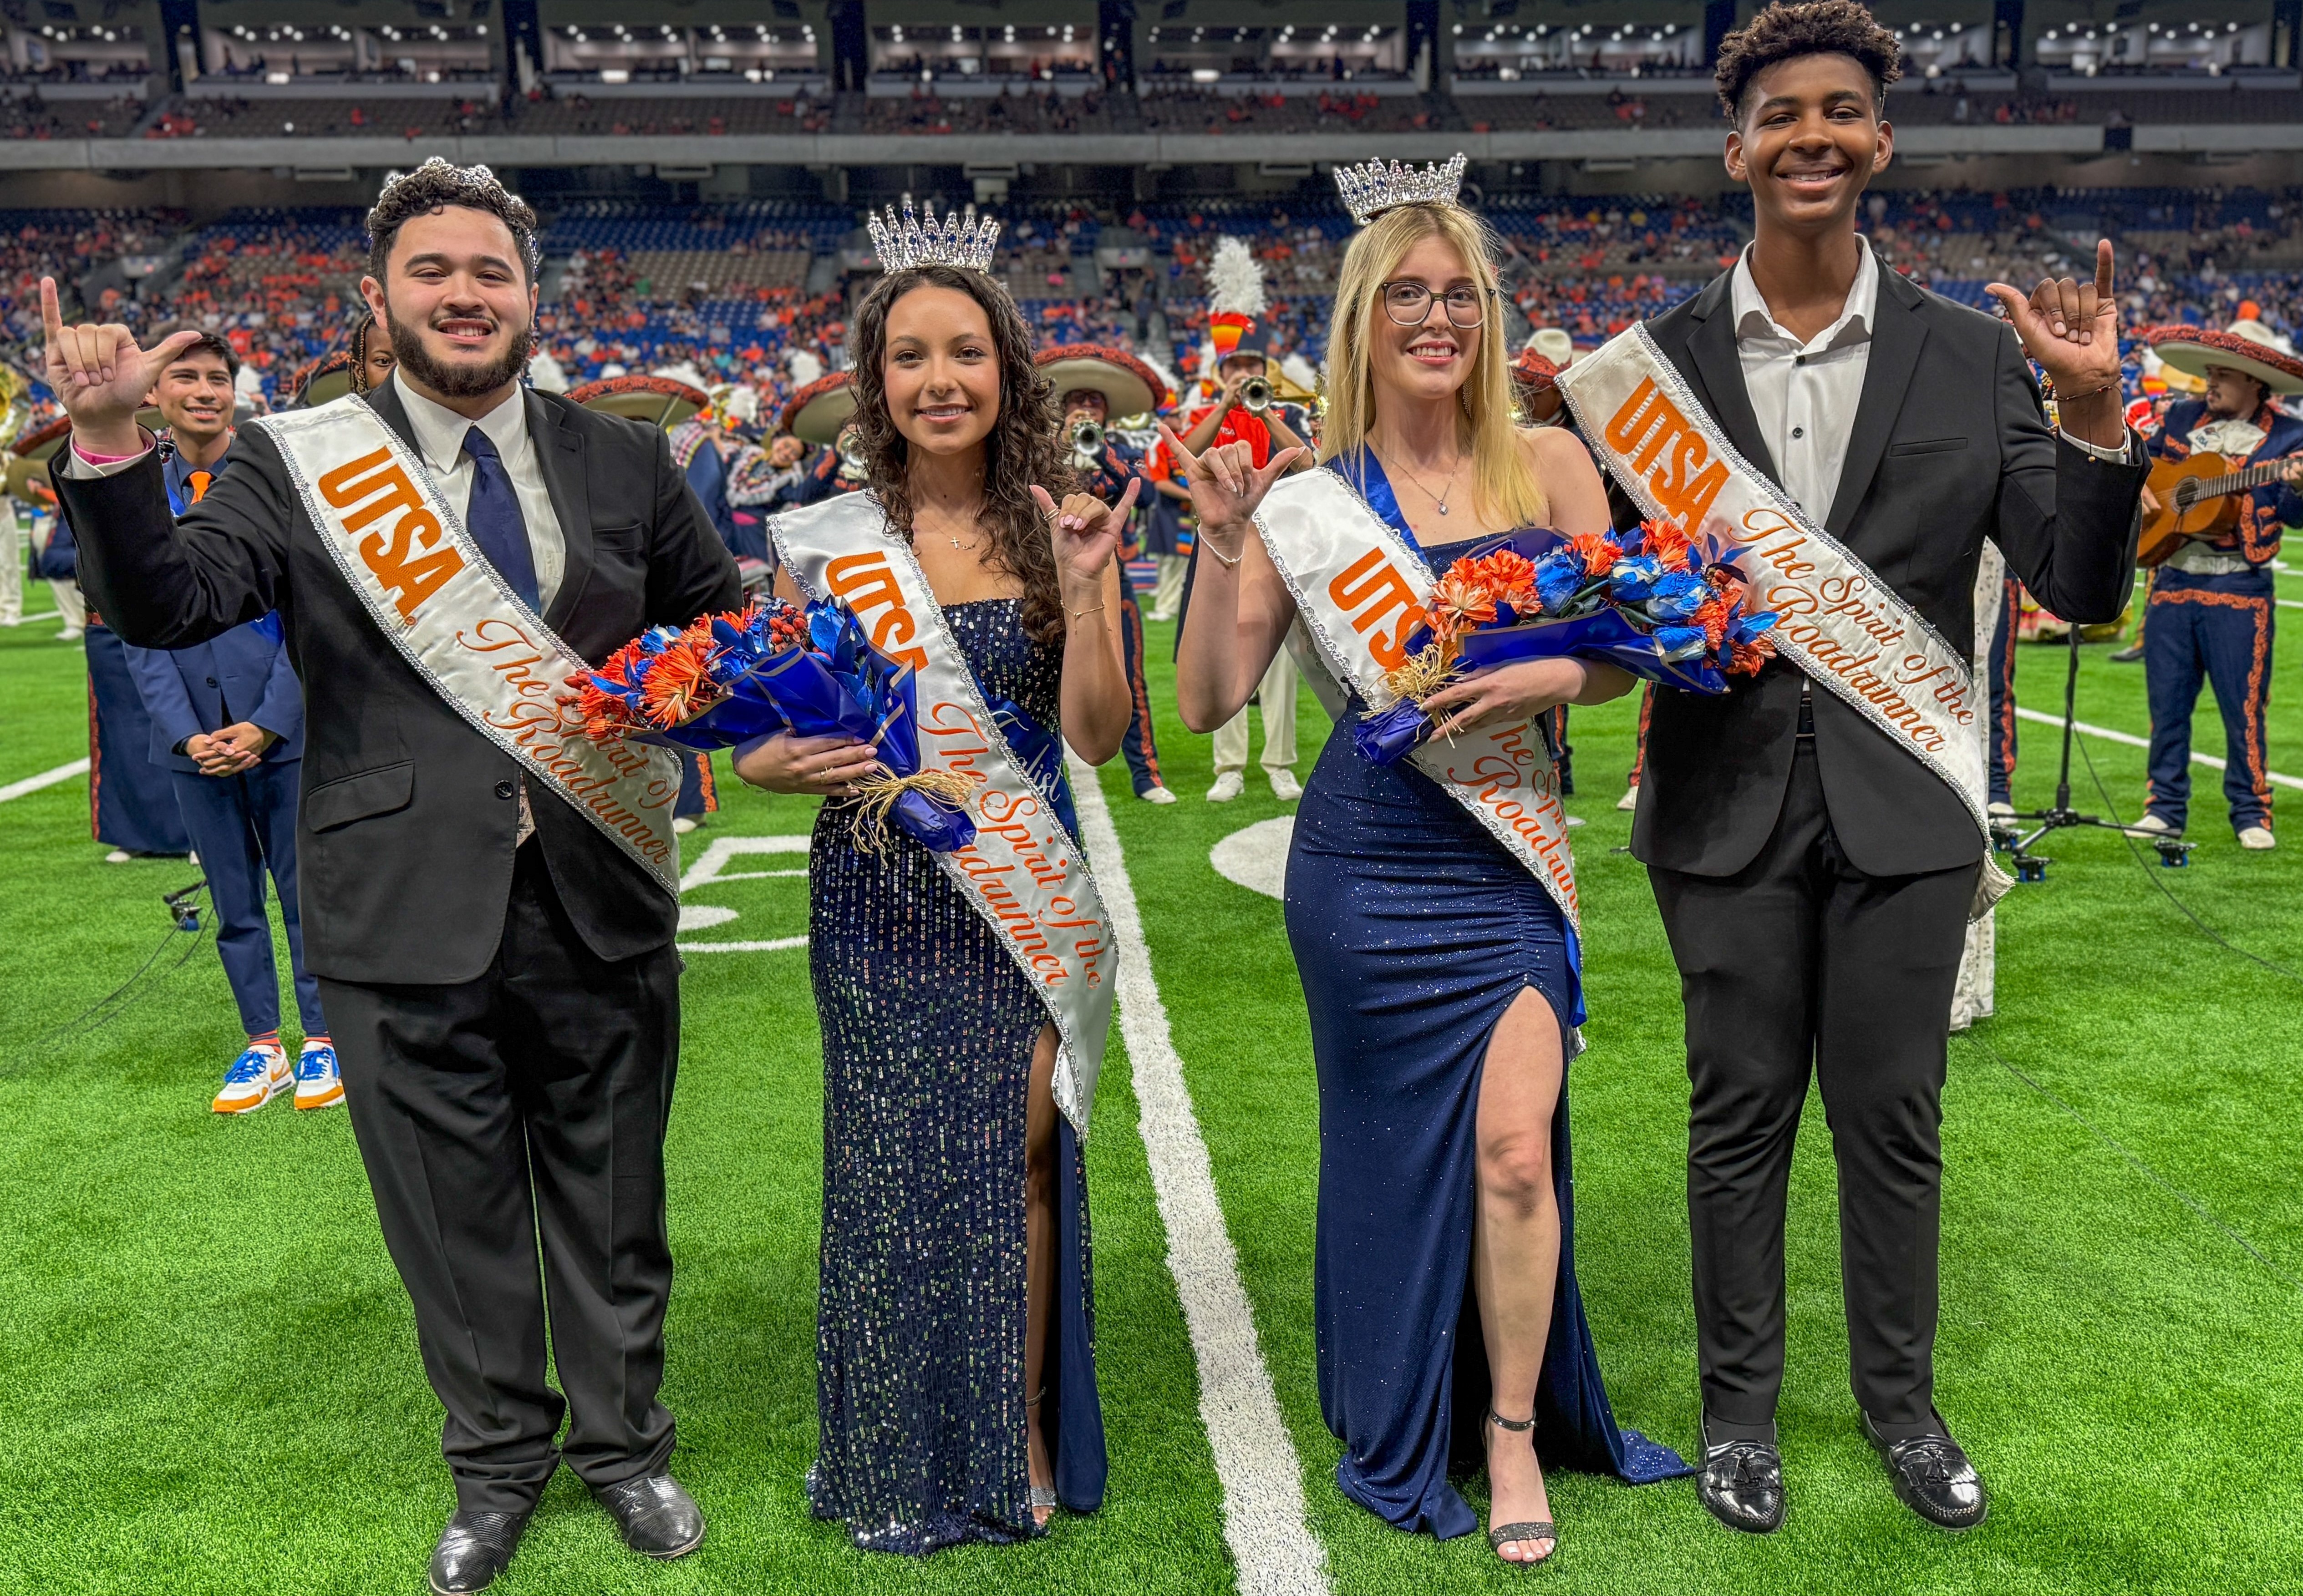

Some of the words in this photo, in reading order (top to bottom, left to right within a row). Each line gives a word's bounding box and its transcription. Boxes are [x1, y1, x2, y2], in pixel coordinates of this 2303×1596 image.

[318, 445, 465, 618] UTSA
[1605, 375, 1730, 540] UTSA
[1328, 546, 1428, 683] UTS
[1728, 508, 1815, 580] The
[1820, 574, 1905, 647] Spirit
[1894, 654, 1954, 684] of
[1934, 681, 1974, 725] the
[1767, 585, 1946, 752] Roadrunner
[457, 619, 549, 697] The
[639, 779, 680, 809] of
[483, 701, 671, 864] Roadrunner
[1489, 723, 1535, 765] he
[918, 702, 989, 783] The
[976, 790, 1066, 890] Spirit
[1038, 895, 1101, 931] of
[1075, 936, 1104, 988] the
